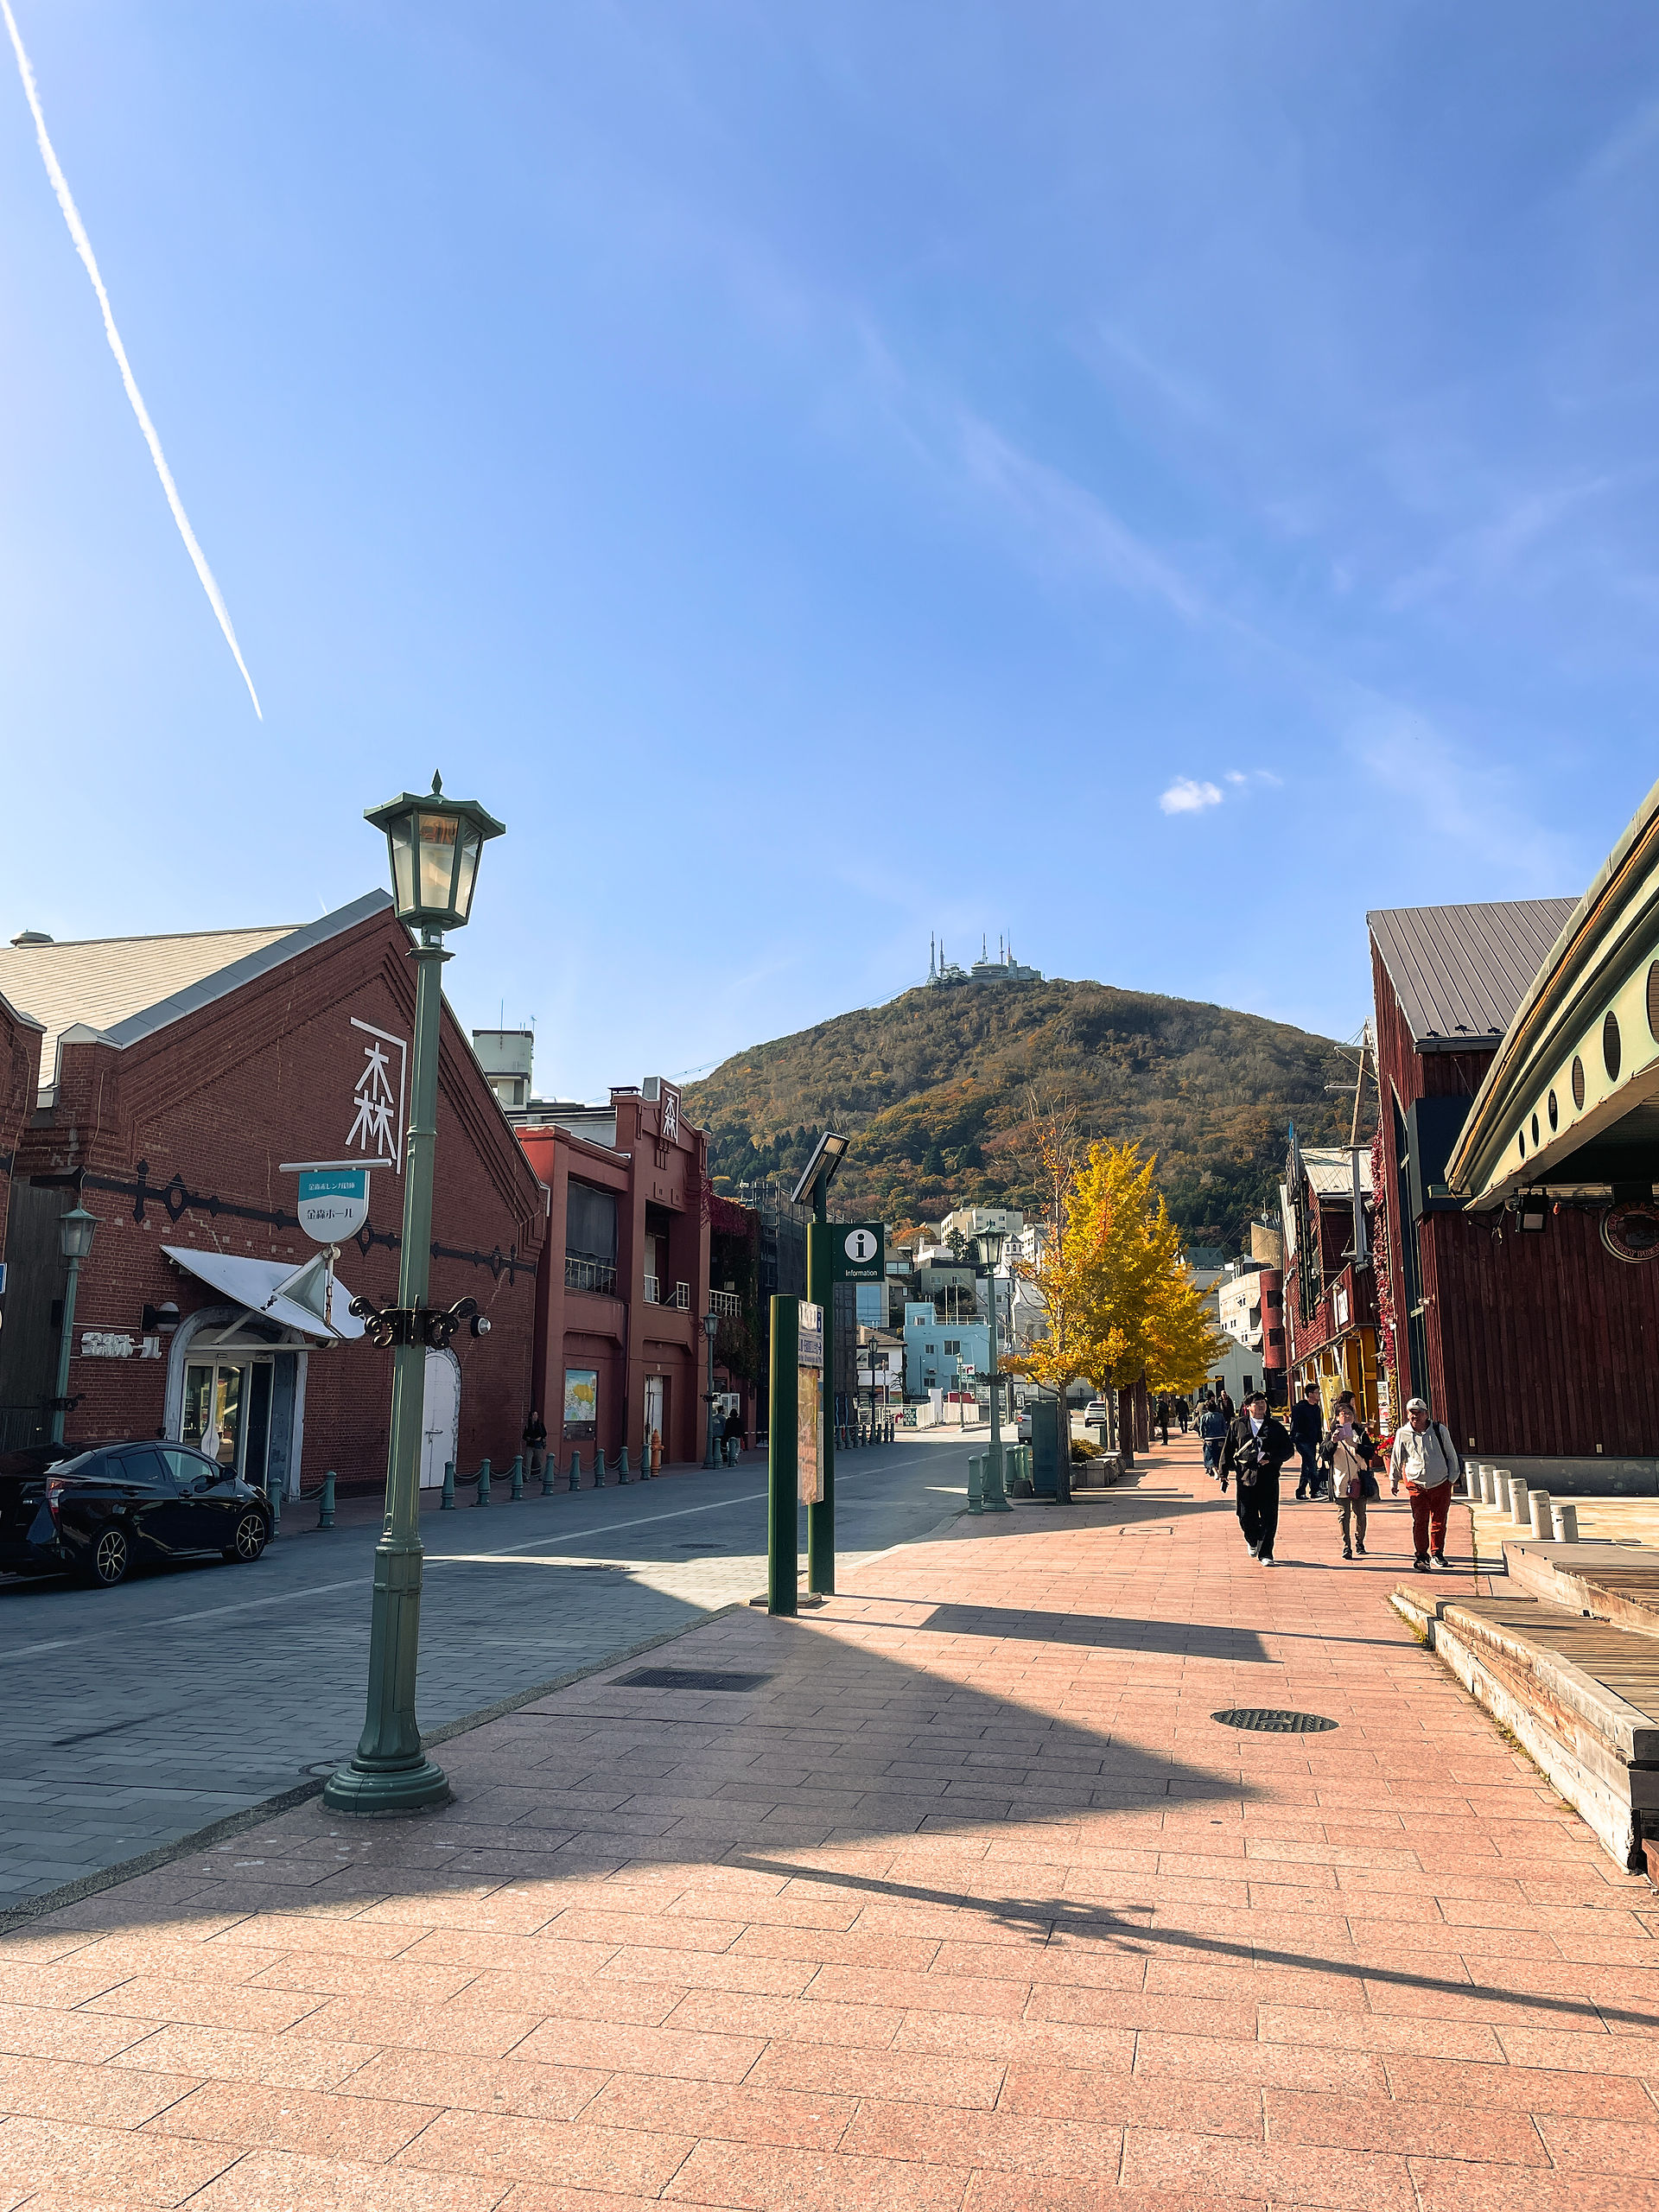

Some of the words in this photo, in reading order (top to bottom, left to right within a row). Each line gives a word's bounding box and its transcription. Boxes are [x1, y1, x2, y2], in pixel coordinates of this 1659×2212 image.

[346, 1041, 397, 1160] 森
[307, 1208, 353, 1219] 金森ホール
